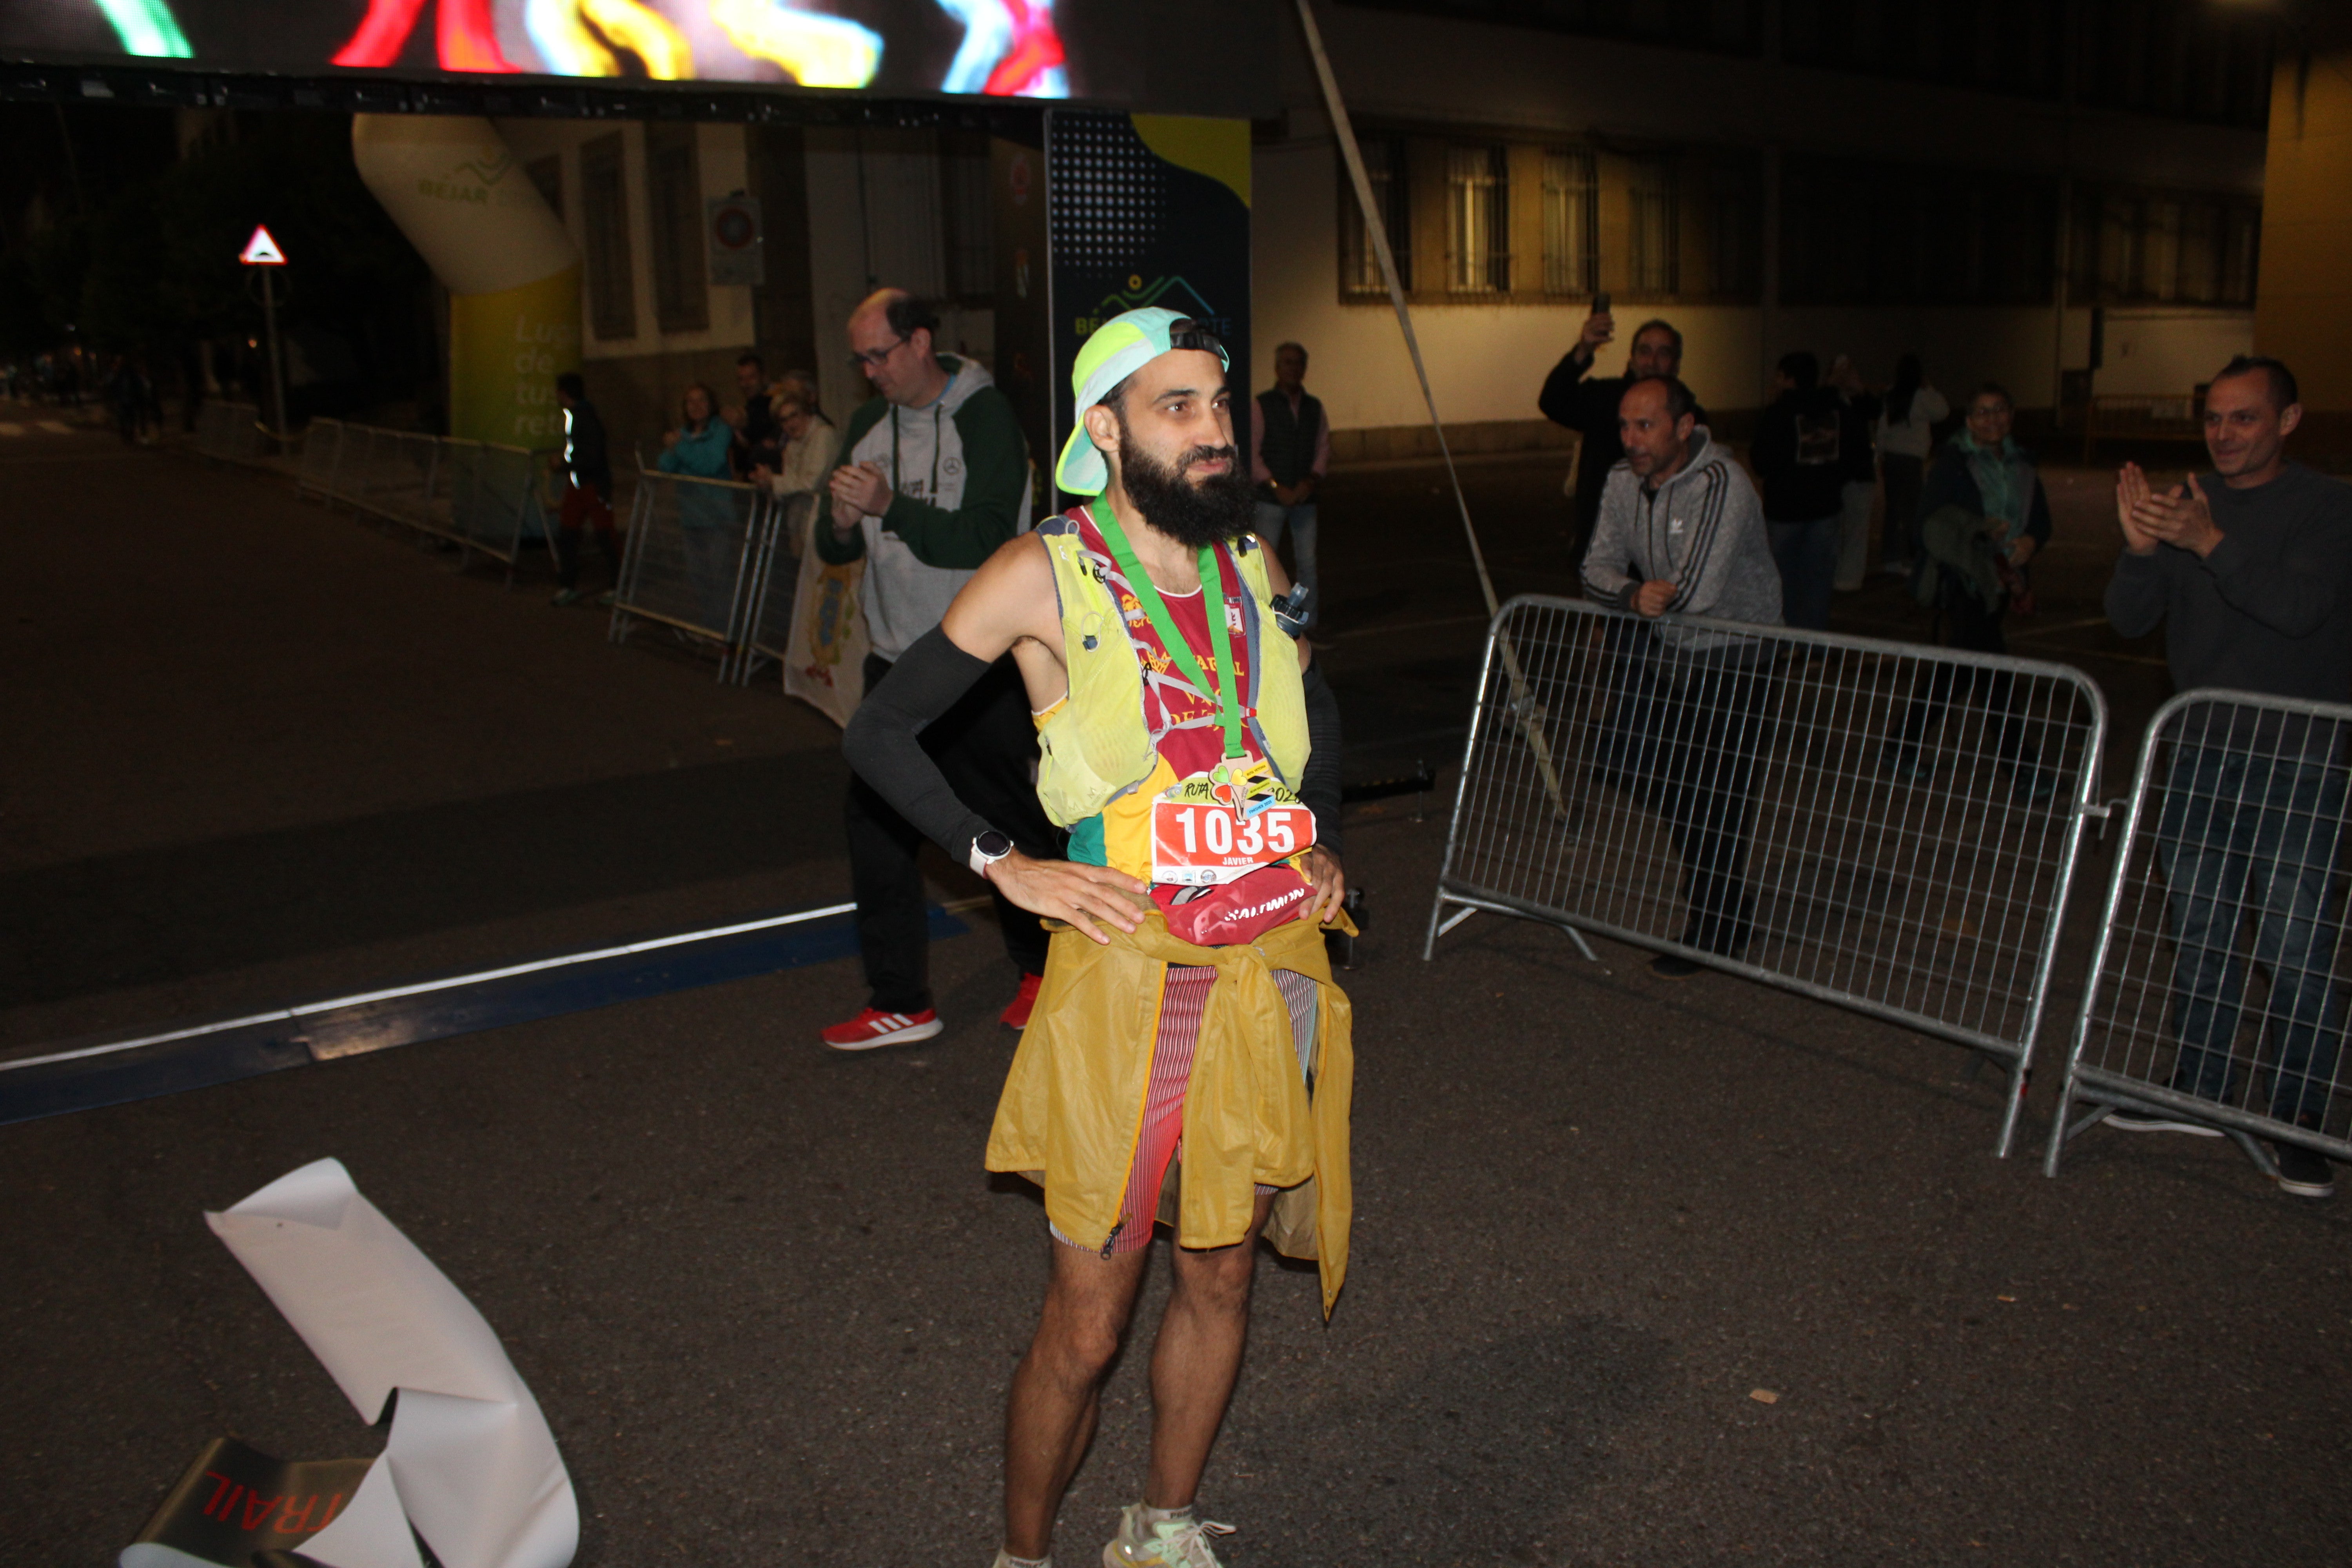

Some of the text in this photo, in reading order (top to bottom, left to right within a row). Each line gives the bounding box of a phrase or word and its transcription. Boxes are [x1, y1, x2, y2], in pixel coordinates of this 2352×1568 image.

[515, 346, 555, 375] de
[1184, 782, 1210, 799] RUTA
[1249, 804, 1264, 814] FINISHER
[1176, 808, 1295, 855] 1035
[1222, 857, 1254, 866] JAVIER
[202, 1470, 343, 1534] TRAIL
